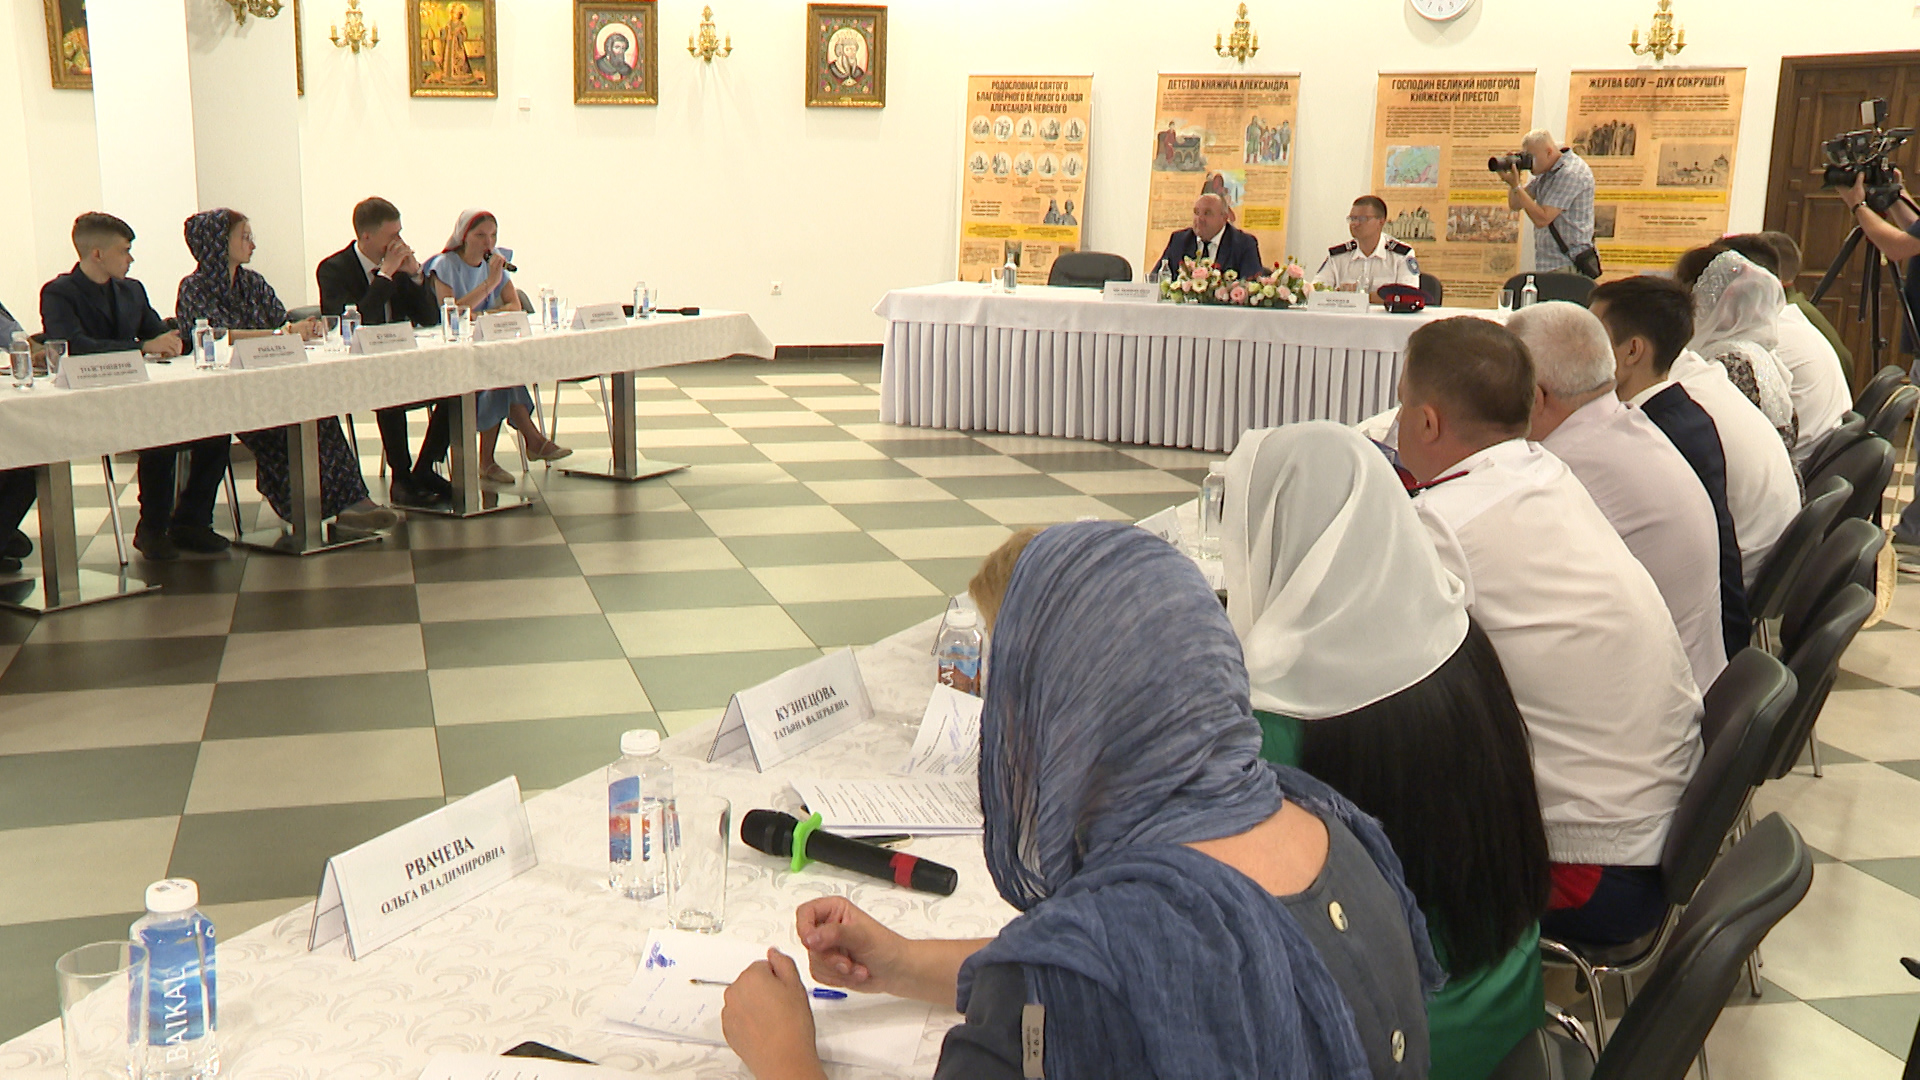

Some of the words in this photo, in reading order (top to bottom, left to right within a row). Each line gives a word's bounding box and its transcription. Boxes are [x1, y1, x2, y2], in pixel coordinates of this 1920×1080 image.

[992, 81, 1038, 91] РОДОСЛОВНАЯ
[1040, 82, 1068, 91] СВЯТОГО
[1168, 80, 1200, 90] ДЕТСТВО
[1200, 80, 1238, 90] КНЯЖИЧА
[1238, 80, 1289, 91] АЛЕКСАНДРА
[1392, 79, 1434, 90] ГОСПОДИН
[1436, 78, 1475, 90] ВЕЛИКИЙ
[1476, 78, 1520, 90] НОВГОРОД
[1588, 77, 1622, 88] ЖЕРТВА
[1624, 77, 1646, 88] БОГУ
[1656, 77, 1675, 88] ДУХ
[976, 92, 1024, 102] БЛАГОВЕРНОГО
[1026, 92, 1060, 102] ВЕЛИКОГО
[1060, 94, 1083, 102] КНЯЗЯ
[1462, 91, 1499, 102] ПРЕСТОЛ
[990, 104, 1032, 114] АЛЕКСАНДРА
[1033, 104, 1067, 114] НЕВСКОГО
[774, 685, 837, 722] КУЗНЕЦОВА
[773, 719, 806, 741] ТАТЬЯНА
[806, 699, 850, 728] ВАЛЕРЬЕВНА
[405, 835, 476, 881] РВАЧЕВА
[380, 888, 419, 916] ОЛЬГА
[420, 845, 506, 896] ВЛАДИМИРОВНА
[163, 967, 190, 1063] BAIKAL
